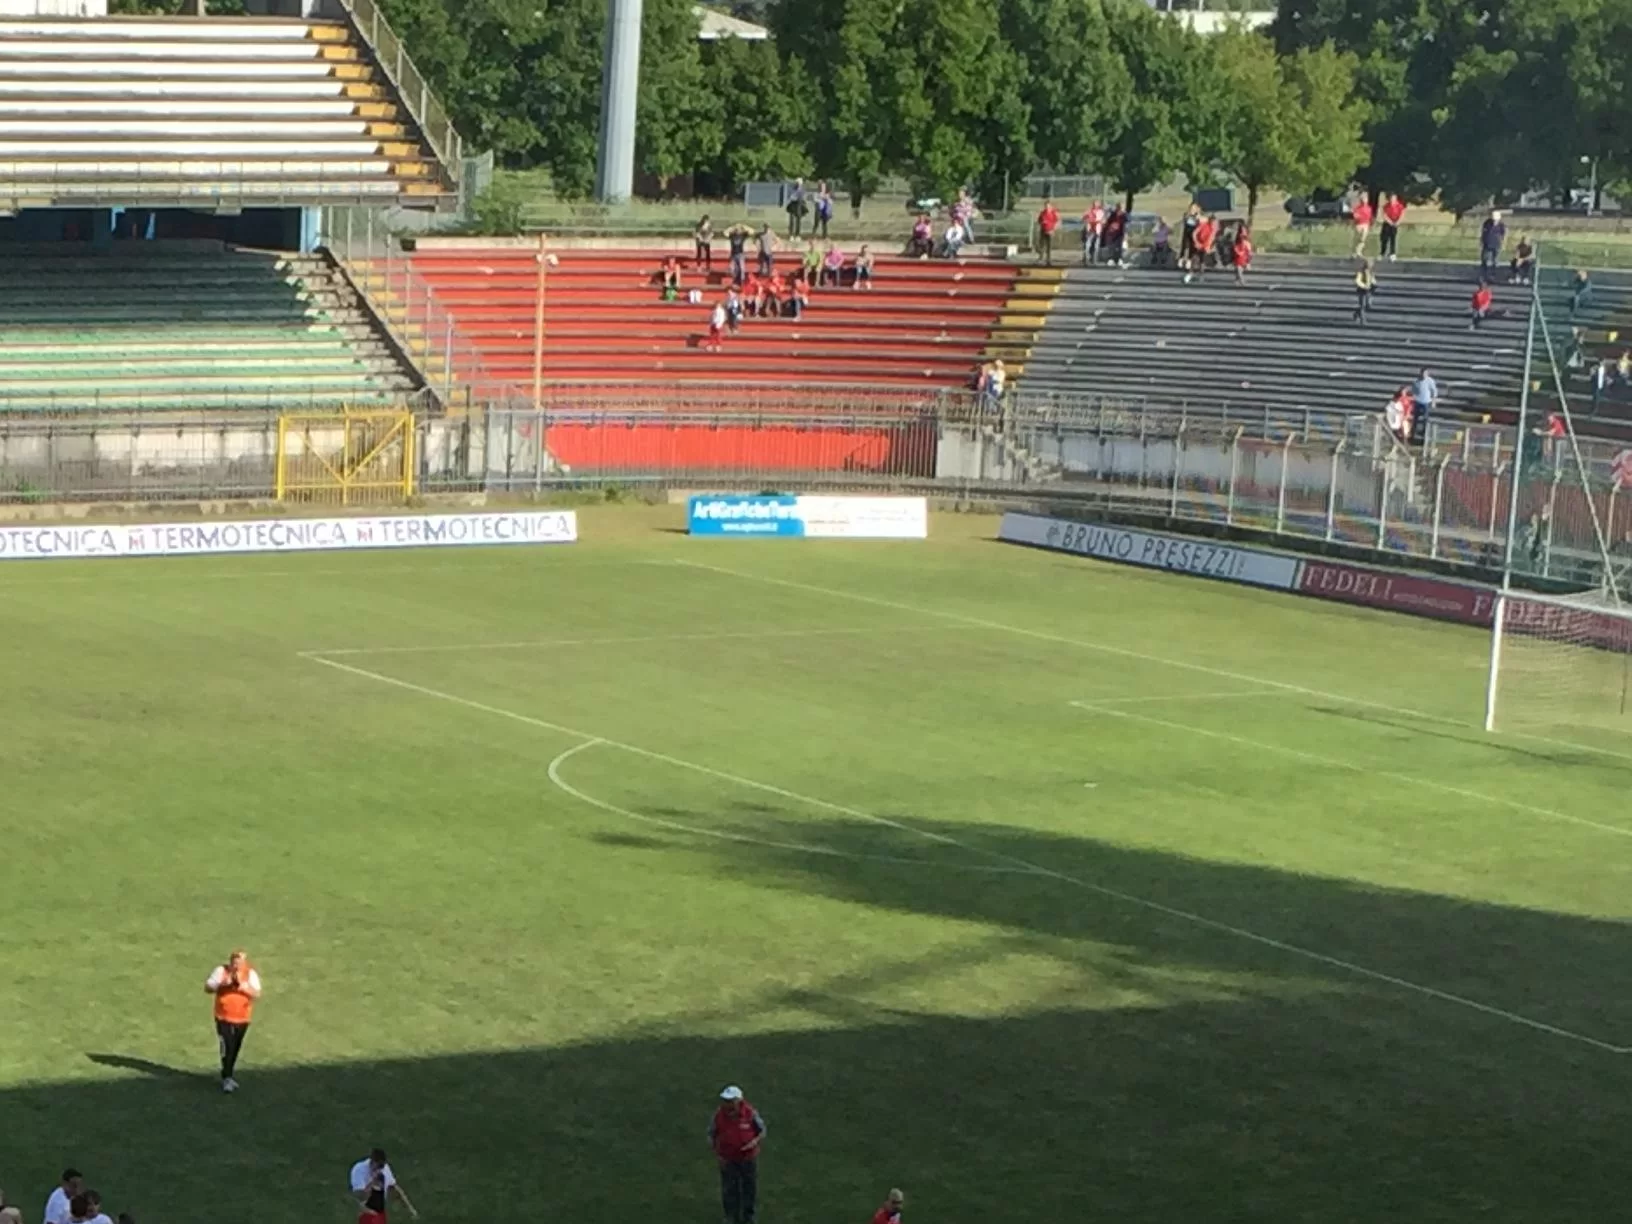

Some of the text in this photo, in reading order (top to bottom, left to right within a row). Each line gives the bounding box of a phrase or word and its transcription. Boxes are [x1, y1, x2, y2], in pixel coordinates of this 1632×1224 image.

[152, 521, 348, 550] TERMOTECNICA
[379, 514, 571, 543] TERMOTECNICA
[1061, 523, 1133, 560] BRUNO
[1143, 537, 1237, 577] PRESEZZI
[1304, 563, 1393, 601] FEDELI
